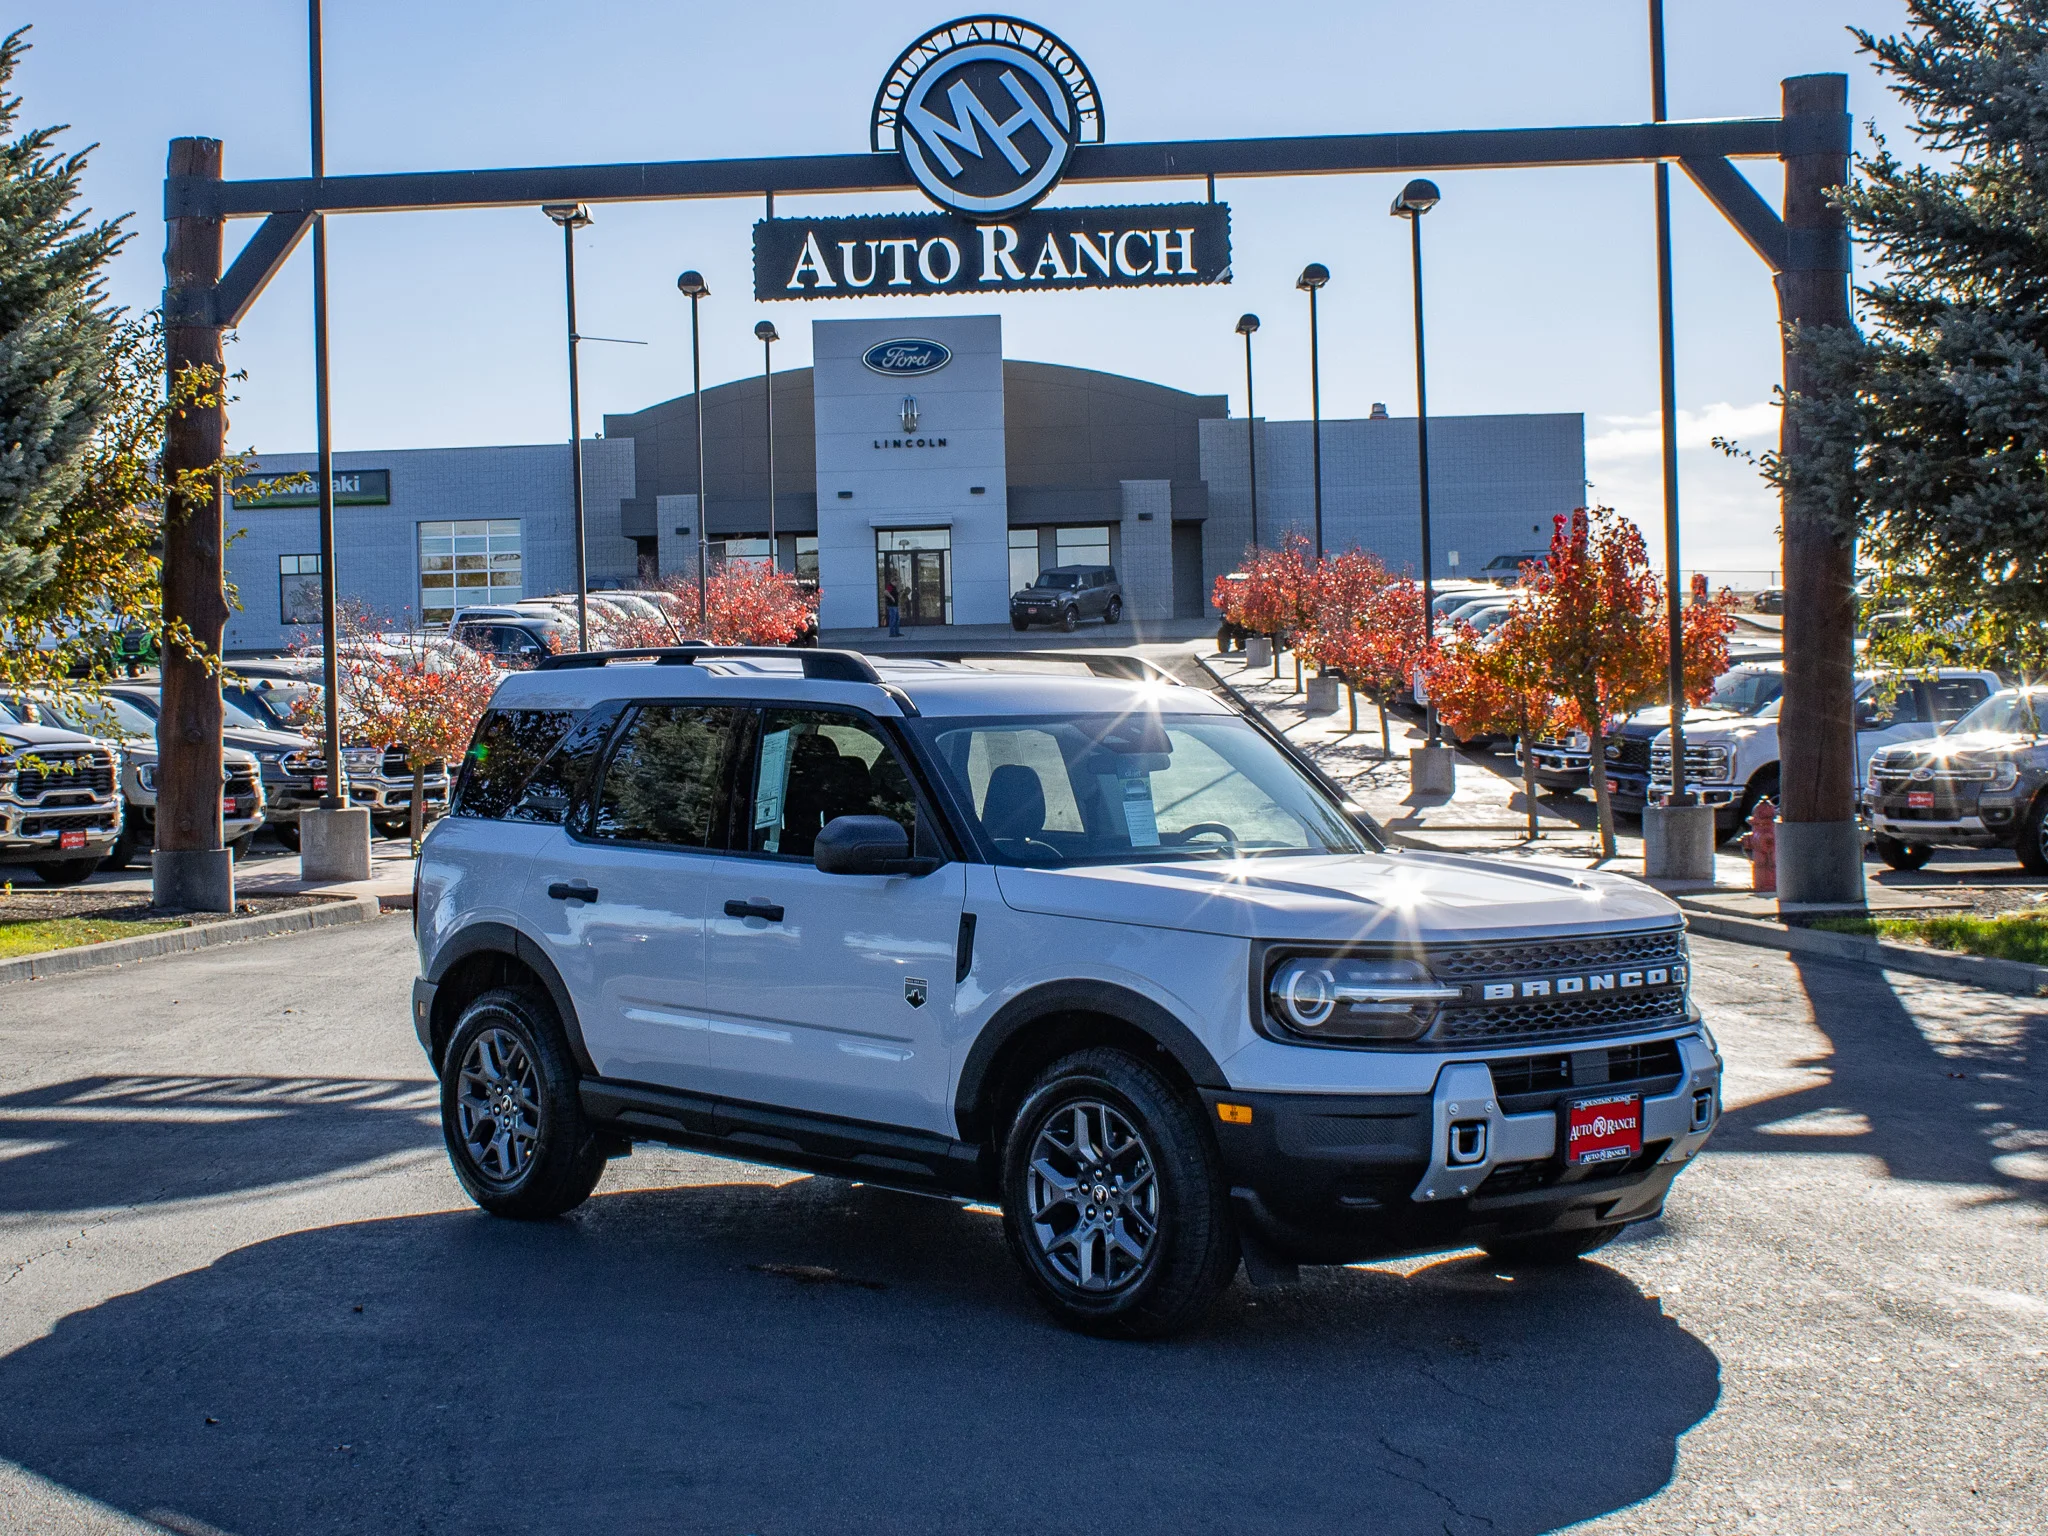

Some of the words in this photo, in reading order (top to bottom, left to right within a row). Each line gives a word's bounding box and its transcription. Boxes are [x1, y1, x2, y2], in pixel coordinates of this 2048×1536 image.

[877, 22, 1024, 128] MOUNTAIN
[1035, 36, 1098, 122] HOME
[786, 231, 960, 290] AUTO
[976, 224, 1197, 283] RANCH
[882, 346, 931, 367] Ford
[874, 438, 947, 449] LINCOLN
[1484, 969, 1667, 1000] BRONCO
[1570, 1124, 1592, 1141] AUTO
[1606, 1117, 1636, 1134] RANCH
